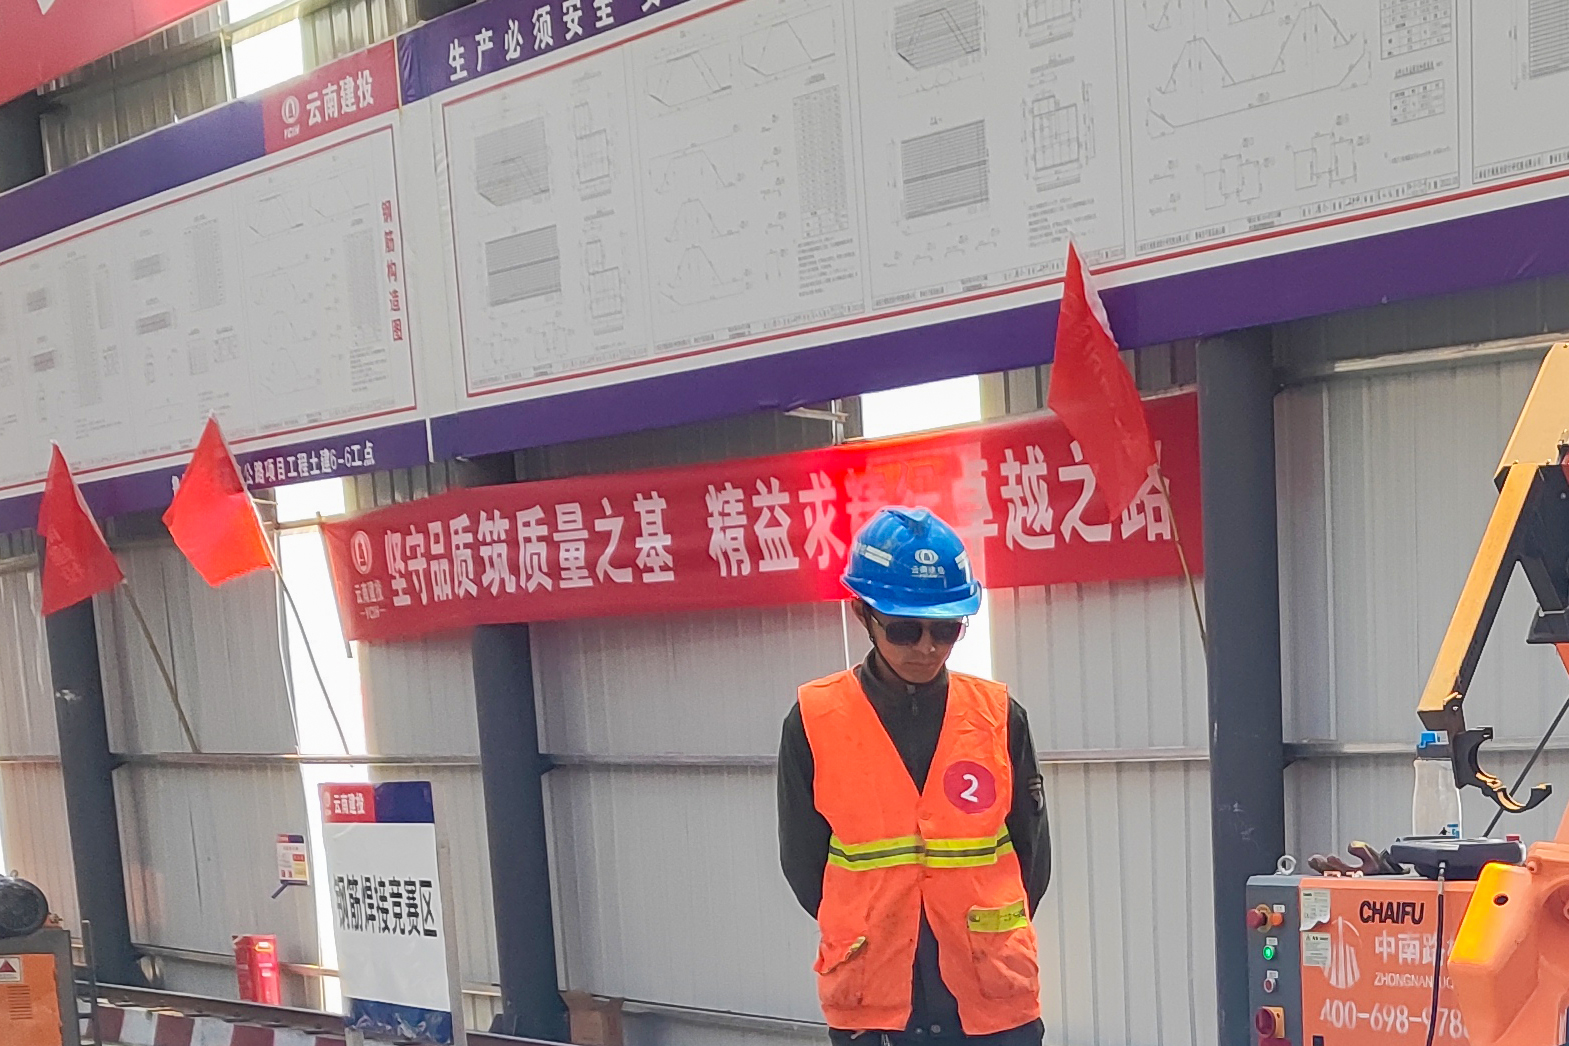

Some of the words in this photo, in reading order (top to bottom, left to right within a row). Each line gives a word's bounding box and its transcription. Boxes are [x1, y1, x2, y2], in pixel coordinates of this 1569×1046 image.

[306, 69, 374, 127] 云南建投
[381, 199, 403, 342] 钢筋构造图
[384, 490, 676, 607] 坚守品质筑质量之基
[333, 792, 366, 816] 云南建投
[960, 773, 979, 803] 2
[333, 873, 438, 938] 钢筋焊接竞赛区
[1359, 900, 1425, 925] CHAIFU
[1319, 998, 1469, 1040] 400-698-978
